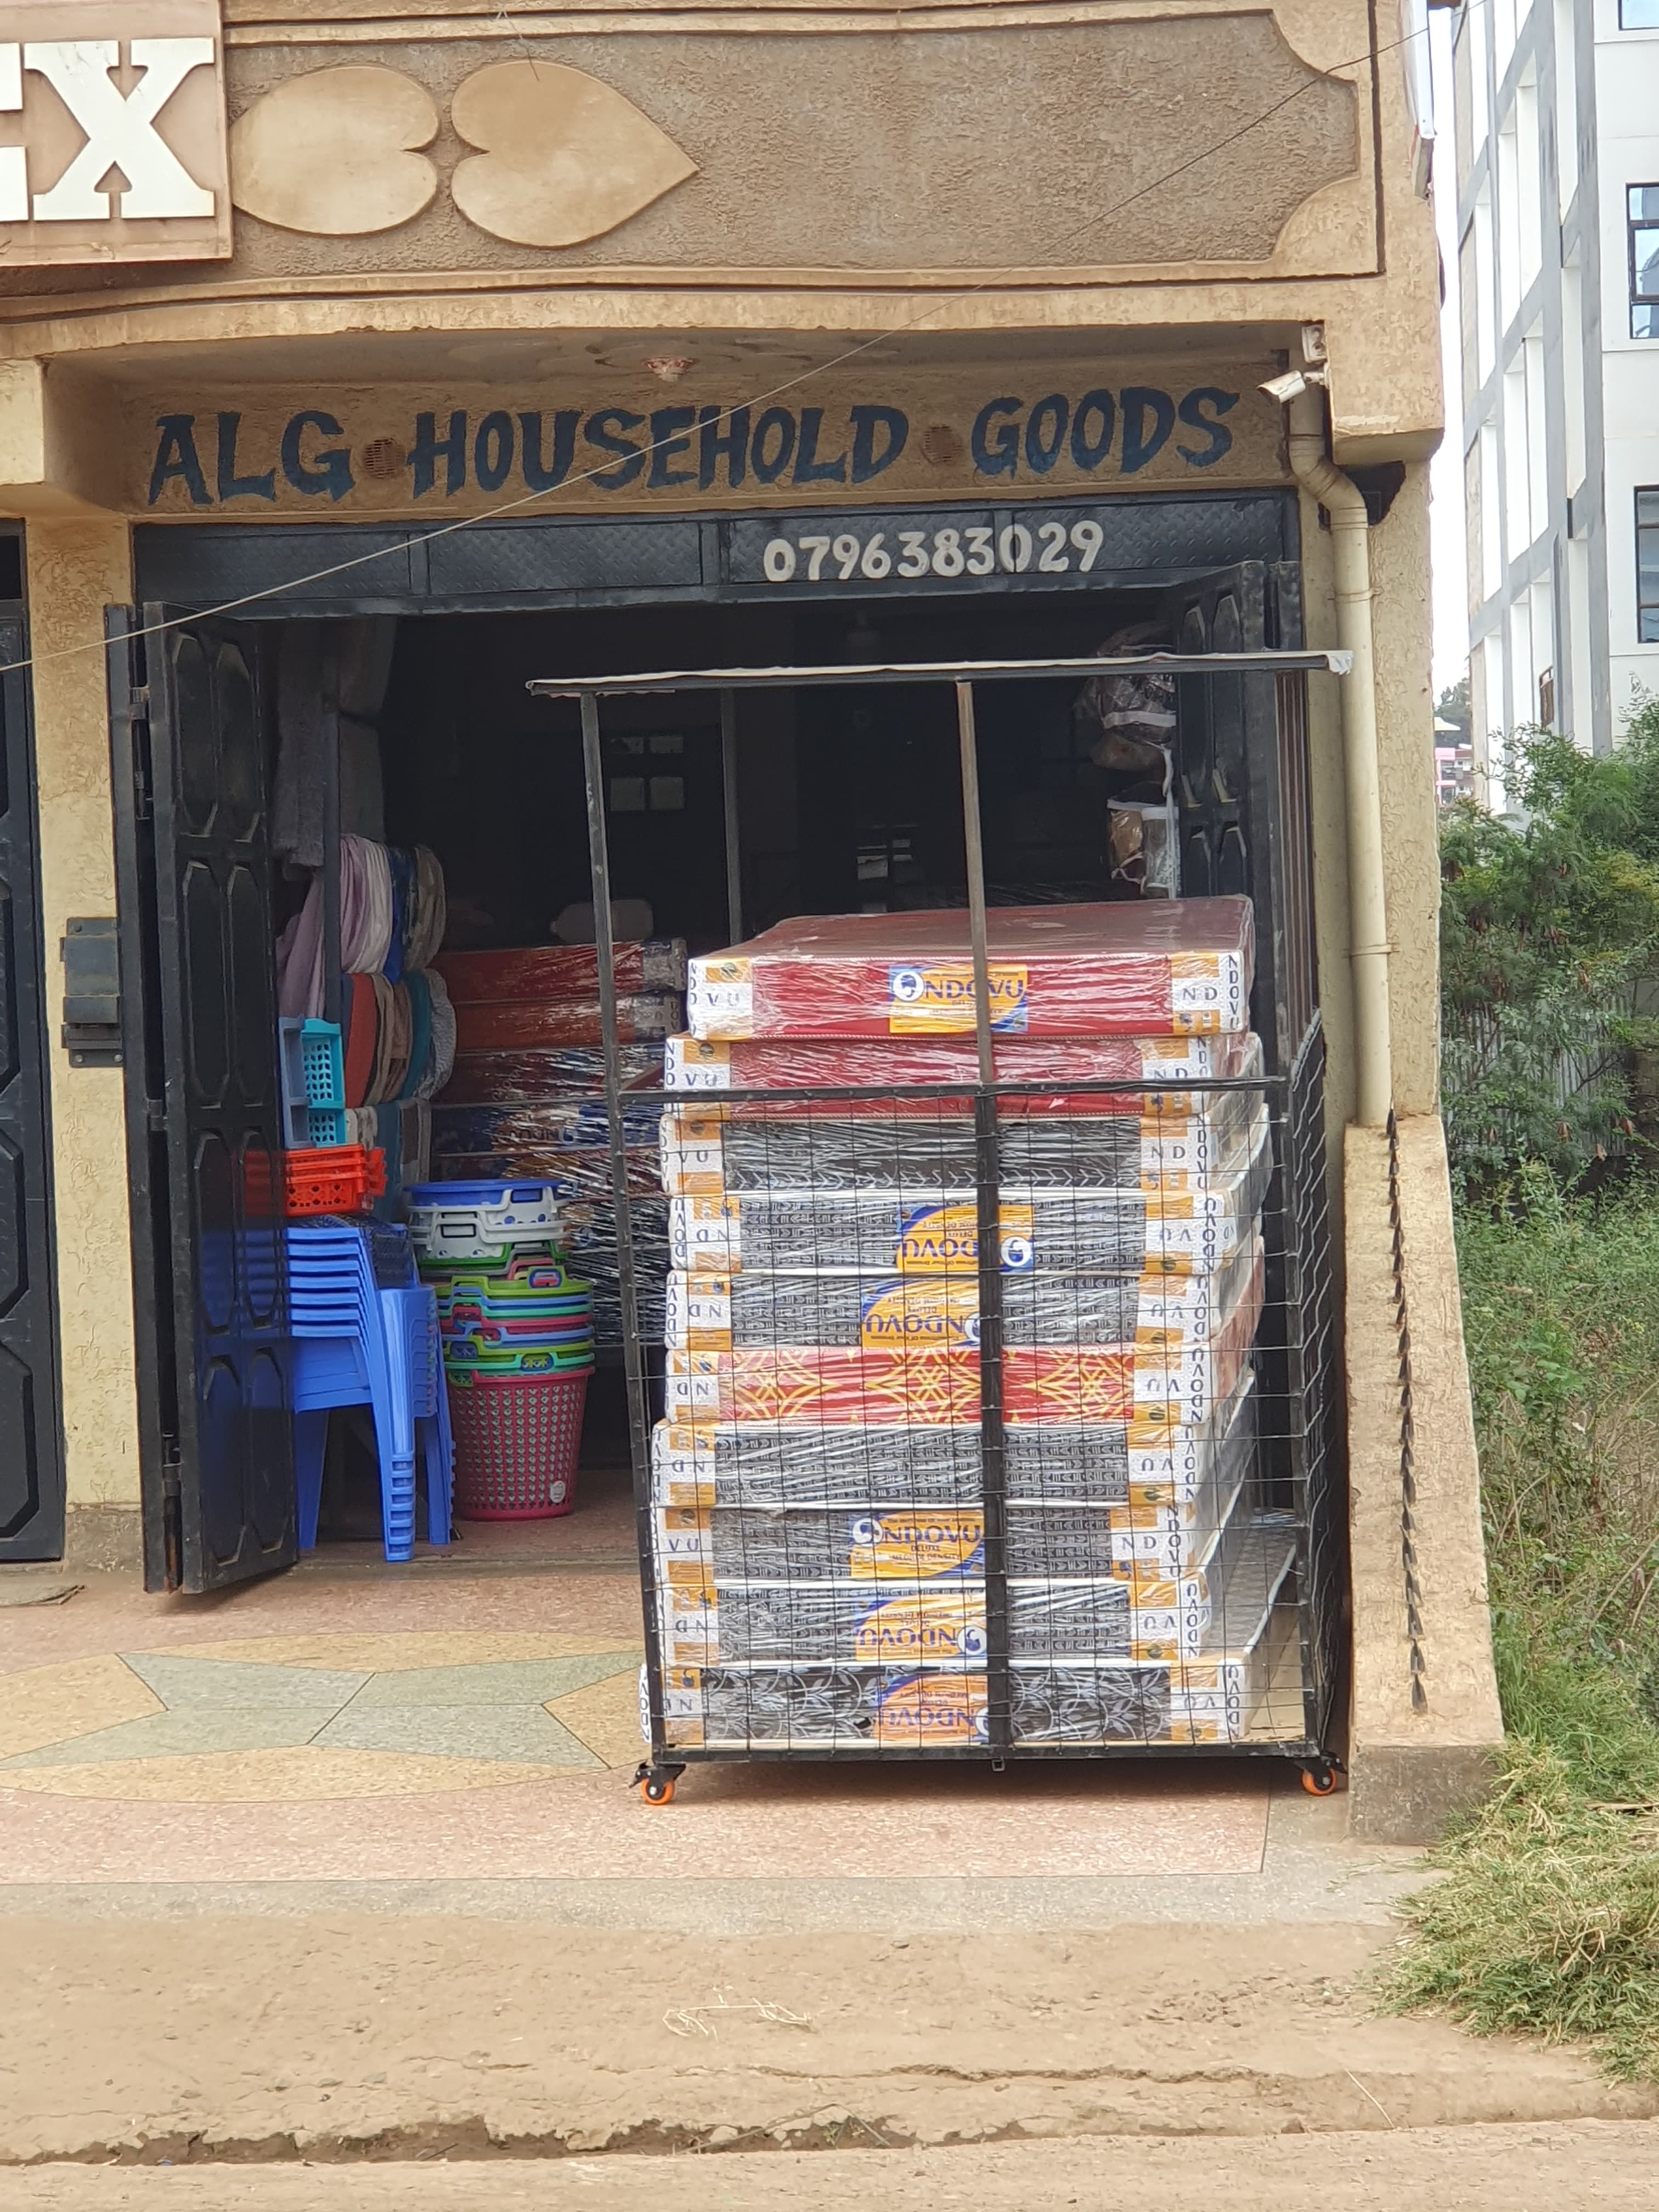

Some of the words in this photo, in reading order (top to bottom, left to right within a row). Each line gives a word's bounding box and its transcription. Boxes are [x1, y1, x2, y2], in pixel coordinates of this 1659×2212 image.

[148, 410, 356, 506] ALG
[406, 405, 909, 499] HOUSEHOLD
[972, 387, 1240, 479] GOODS
[763, 520, 1104, 582] 0796383029
[1229, 955, 1239, 1030] NDOVU
[901, 1239, 979, 1258] DOVU
[866, 1314, 964, 1334] NDOVU
[1190, 1348, 1204, 1423] NDOVU
[884, 1525, 980, 1544] NDOVU
[860, 1628, 957, 1647] NDOVU
